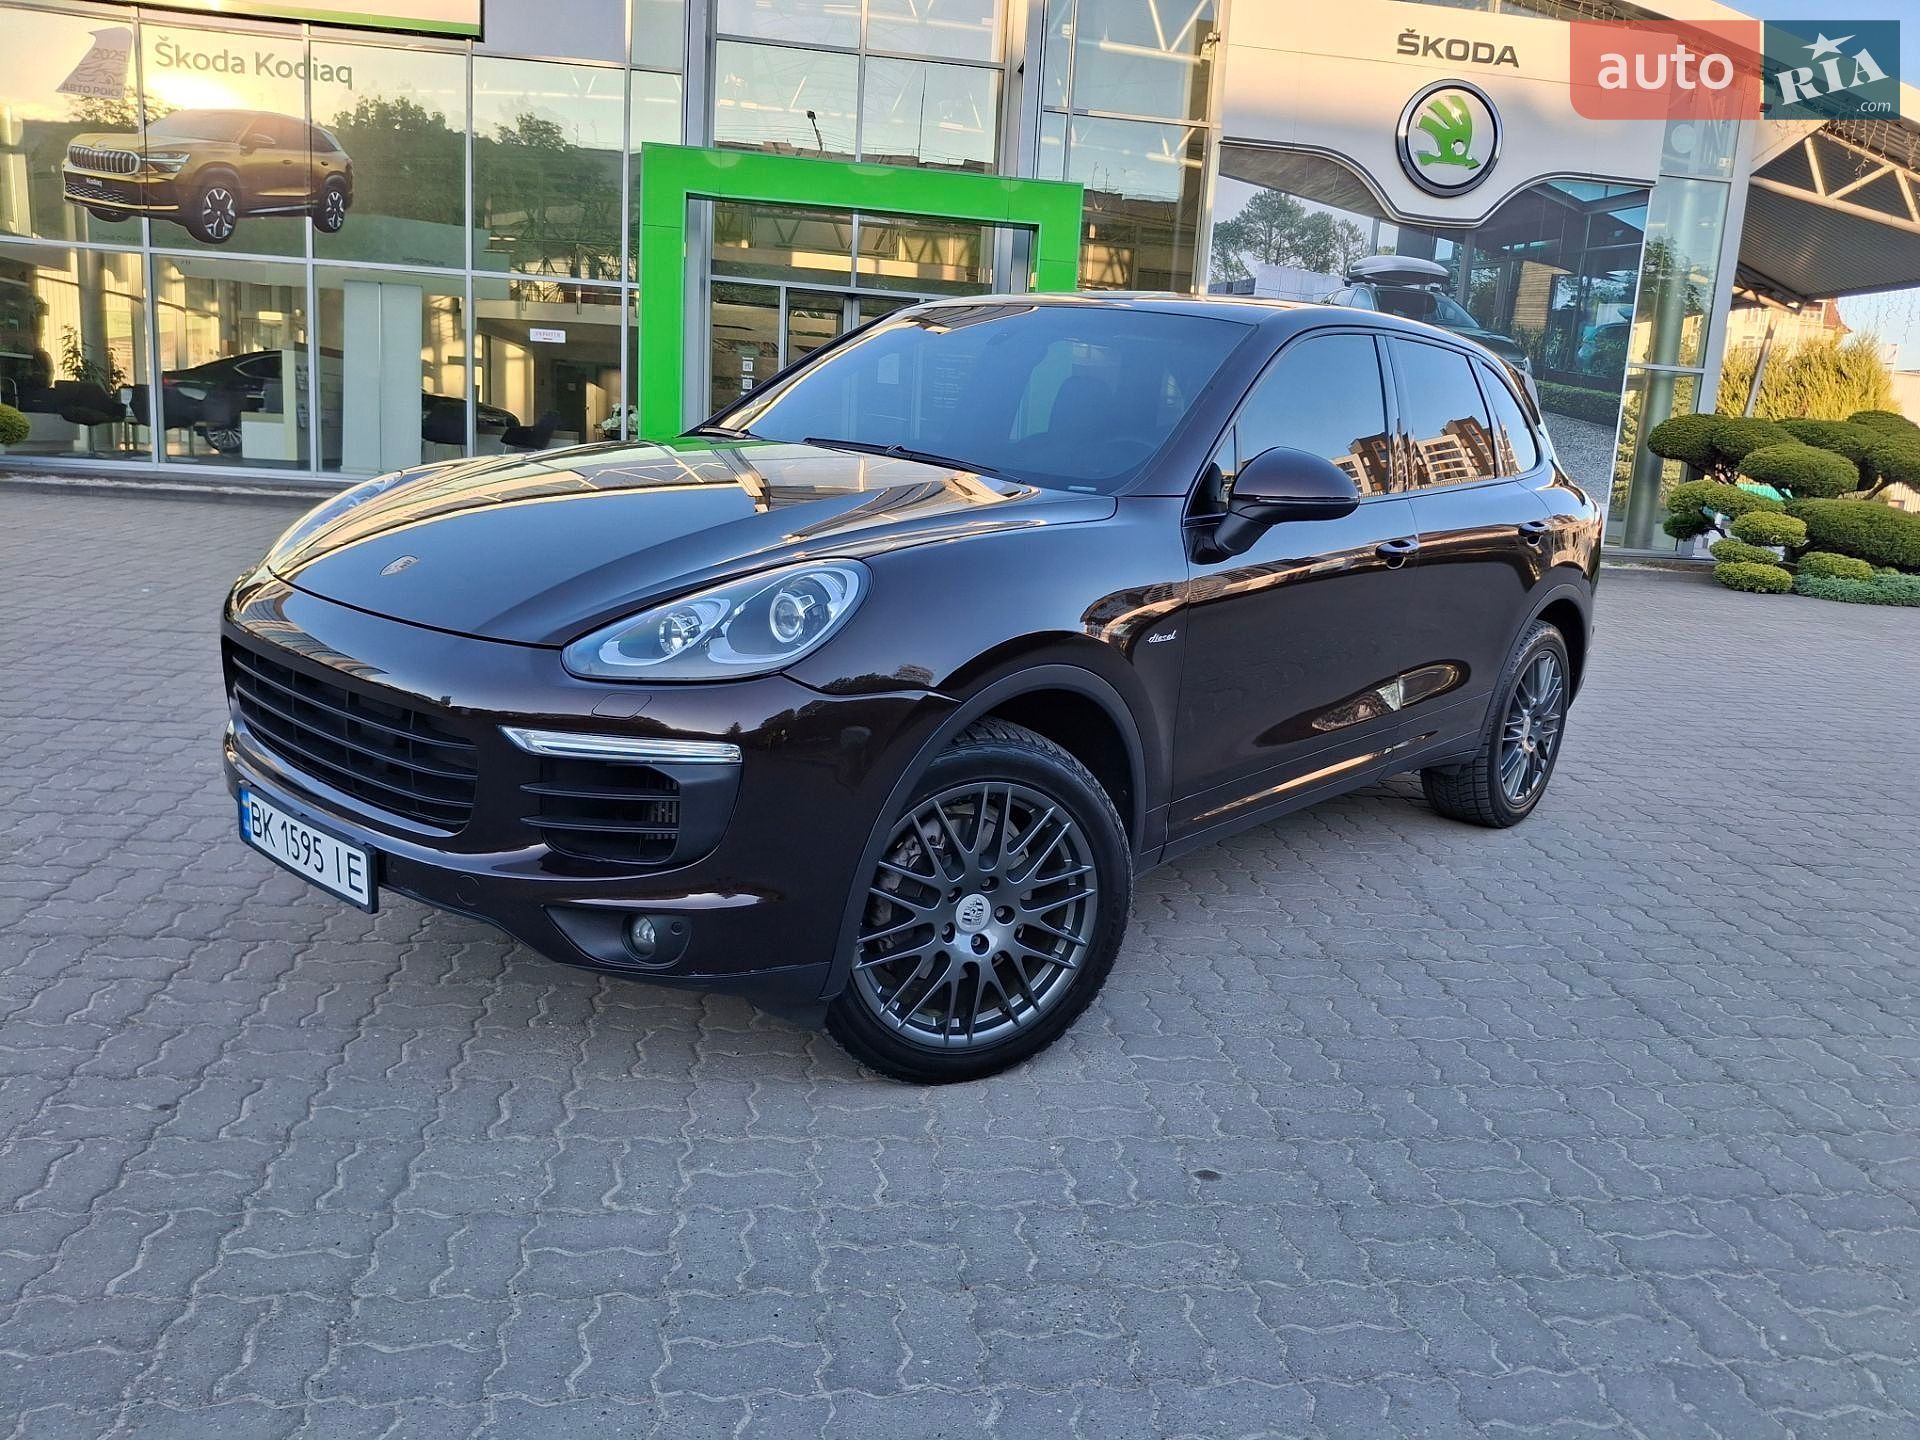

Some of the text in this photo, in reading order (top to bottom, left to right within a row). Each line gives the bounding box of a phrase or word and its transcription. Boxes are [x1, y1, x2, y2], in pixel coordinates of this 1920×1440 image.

[91, 47, 127, 63] 2025
[154, 35, 353, 90] Škoda Kodiaq
[1397, 28, 1520, 68] ŠKODA
[1147, 629, 1177, 644] diesel
[250, 801, 363, 894] BK 1595 IE
